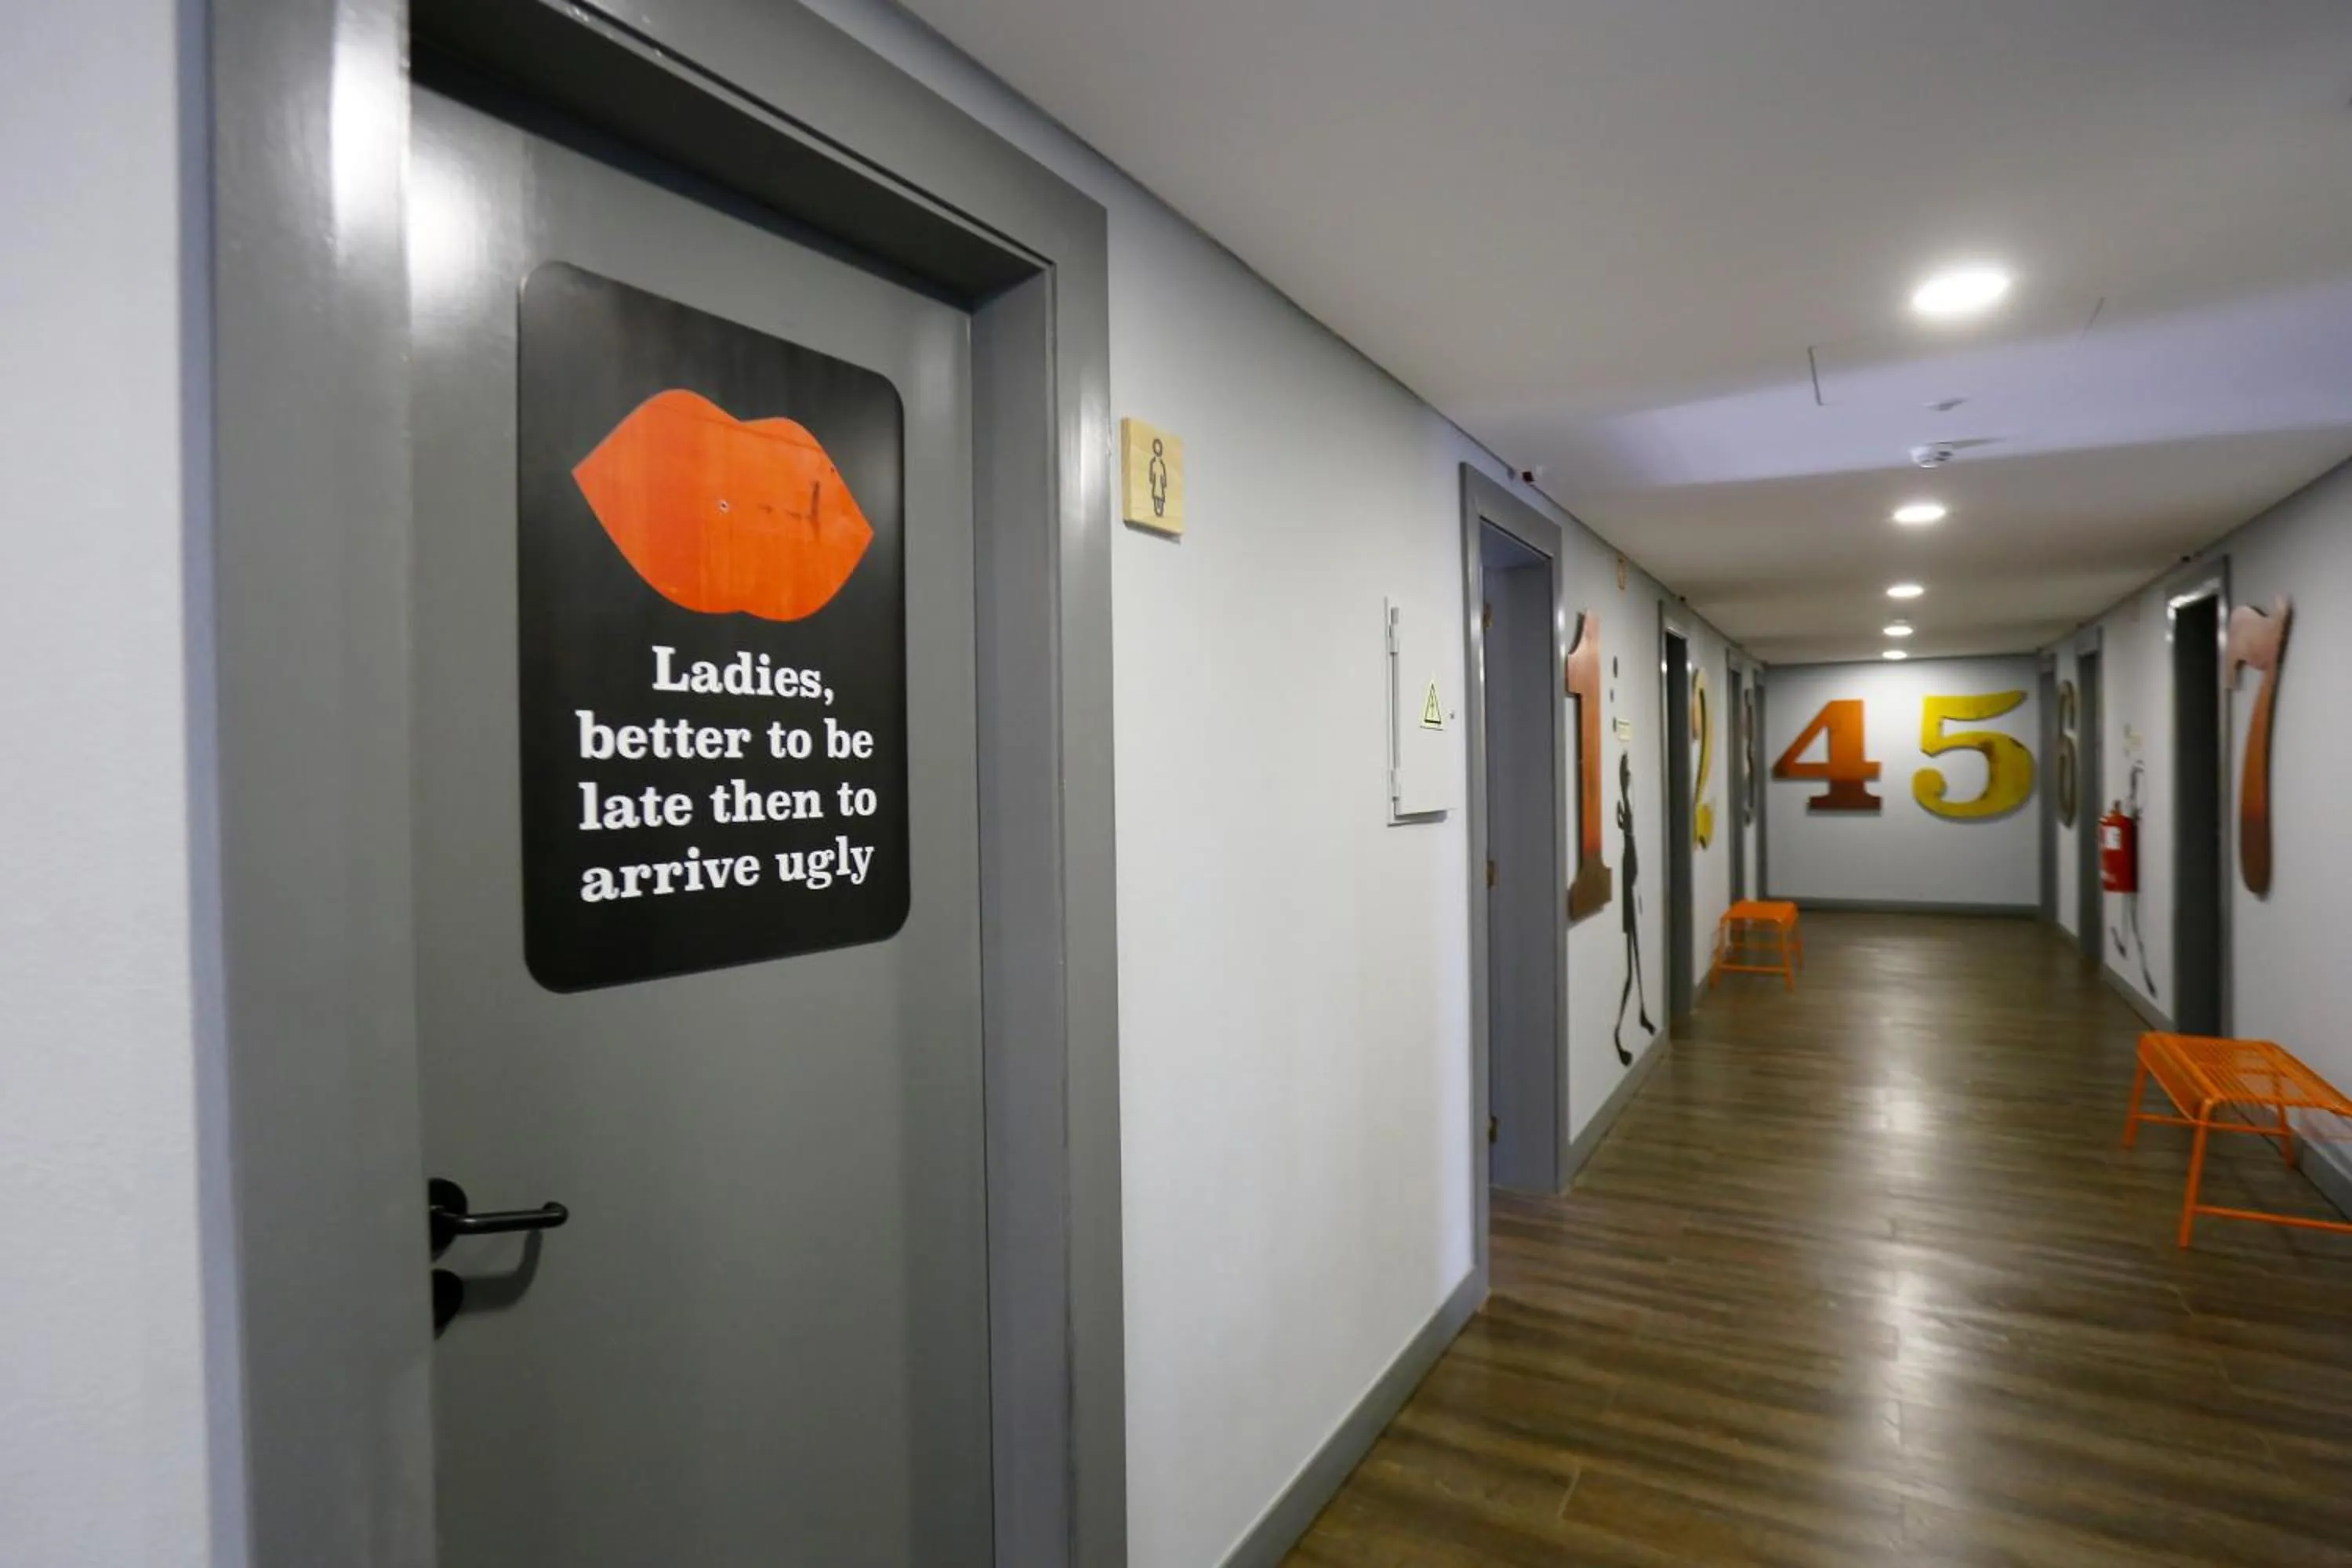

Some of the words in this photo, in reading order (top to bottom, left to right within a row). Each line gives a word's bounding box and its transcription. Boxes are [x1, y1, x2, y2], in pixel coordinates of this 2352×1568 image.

[652, 645, 835, 706] Ladies,
[575, 710, 752, 760] better
[766, 721, 812, 759] to
[823, 717, 874, 759] be
[1566, 608, 1612, 922] 1
[1771, 699, 1882, 811] 4
[1911, 690, 2034, 819] 5
[2223, 593, 2292, 900] 7
[578, 782, 693, 830] late
[709, 779, 824, 824] then
[837, 782, 877, 816] to
[580, 846, 760, 902] arrive
[775, 835, 874, 890] ugly
